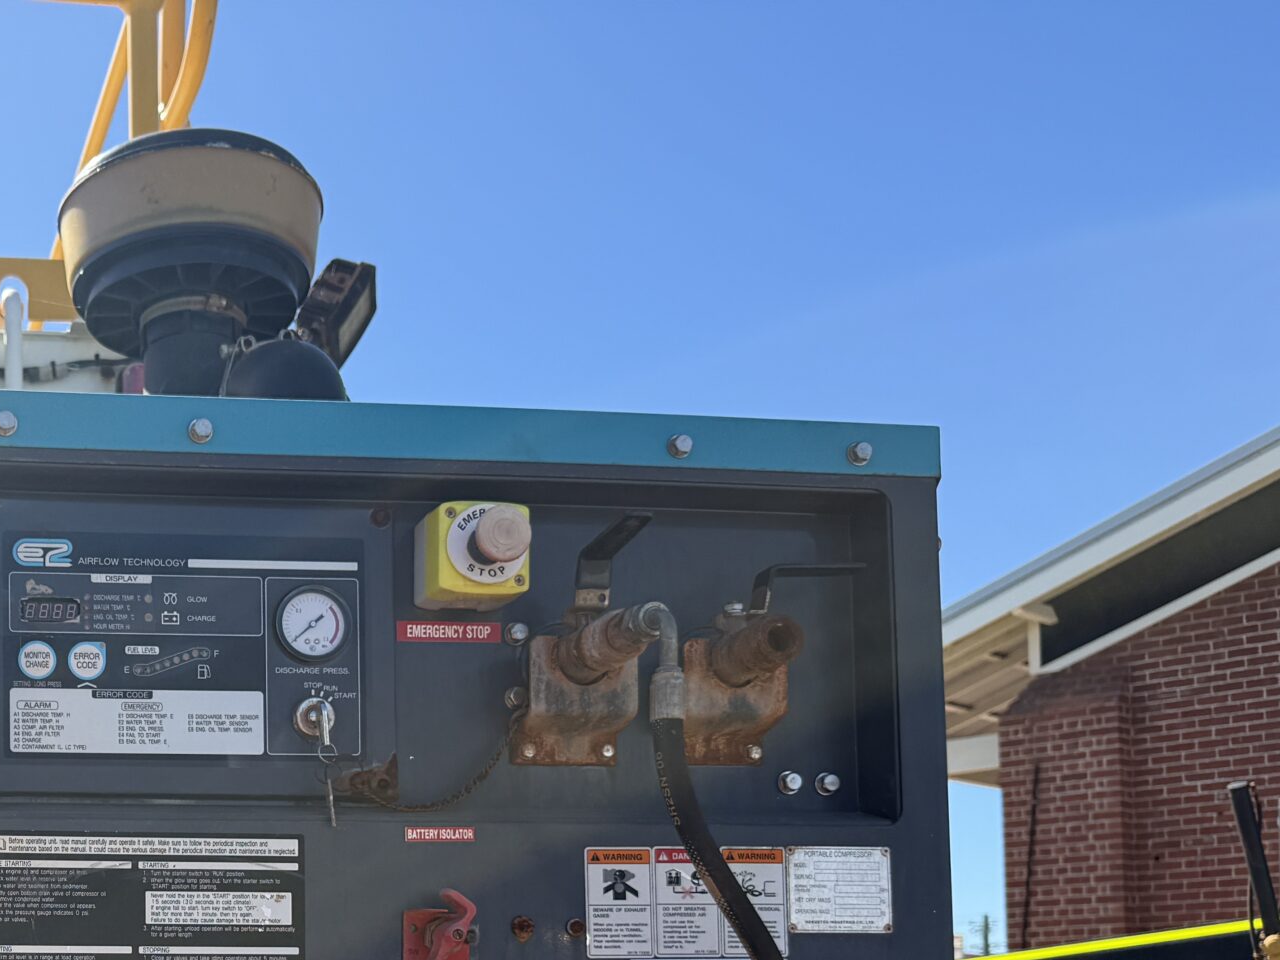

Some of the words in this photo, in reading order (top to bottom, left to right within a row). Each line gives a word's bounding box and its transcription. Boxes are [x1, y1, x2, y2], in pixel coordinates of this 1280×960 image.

[78, 557, 119, 565] AIRFLOW
[124, 558, 185, 567] TECHNOLOGY
[467, 564, 505, 577] STOP
[407, 624, 463, 638] EMERGENCY
[466, 625, 491, 638] STOP
[25, 660, 49, 668] CHANGE
[77, 661, 98, 669] CODE
[407, 829, 438, 839] BATTERY
[439, 830, 474, 839] ISOLATOR
[26, 838, 47, 846] operating
[89, 838, 107, 846] carefully
[212, 840, 234, 848] periodical
